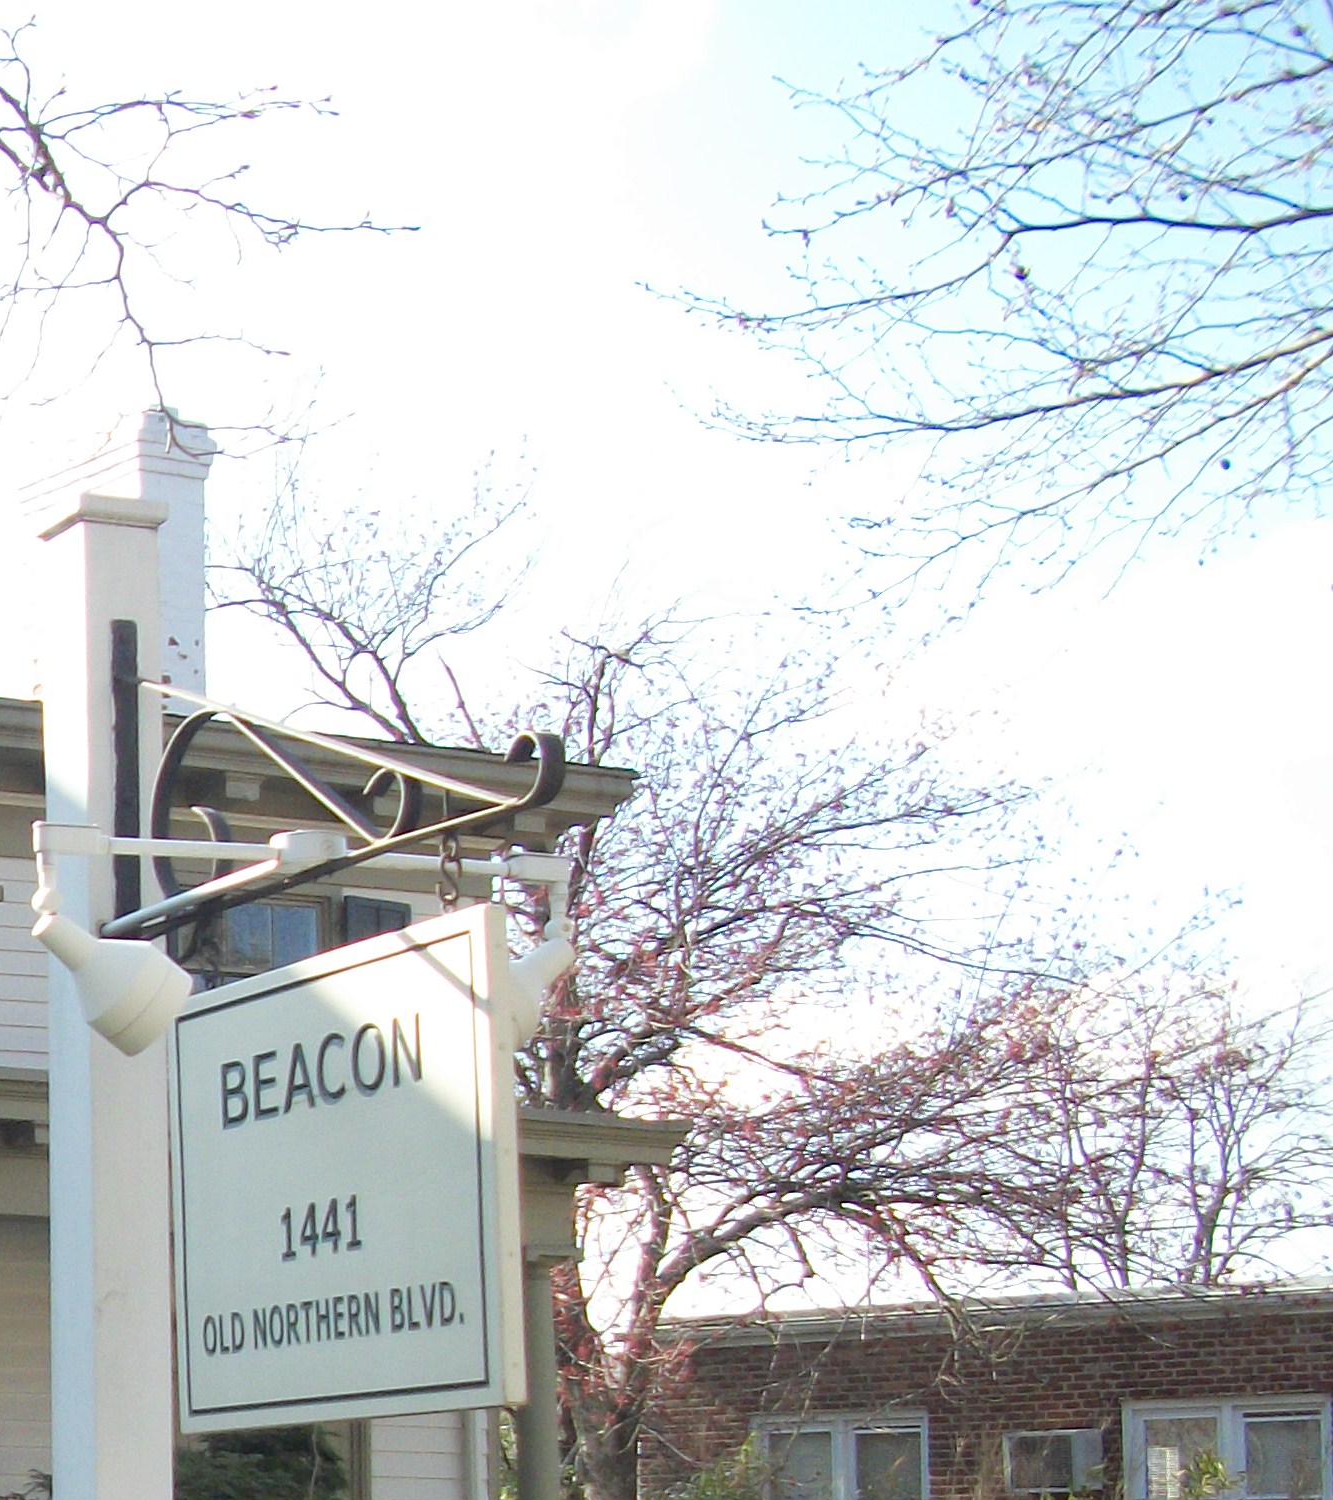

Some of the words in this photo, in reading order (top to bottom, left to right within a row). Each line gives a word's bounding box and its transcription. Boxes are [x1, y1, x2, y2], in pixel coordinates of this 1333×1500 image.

[219, 1012, 423, 1130] BEACON
[279, 1194, 363, 1262] 1441
[202, 1313, 245, 1357] OLD
[252, 1291, 381, 1350] NORTHERN
[390, 1280, 465, 1334] BLVD.
